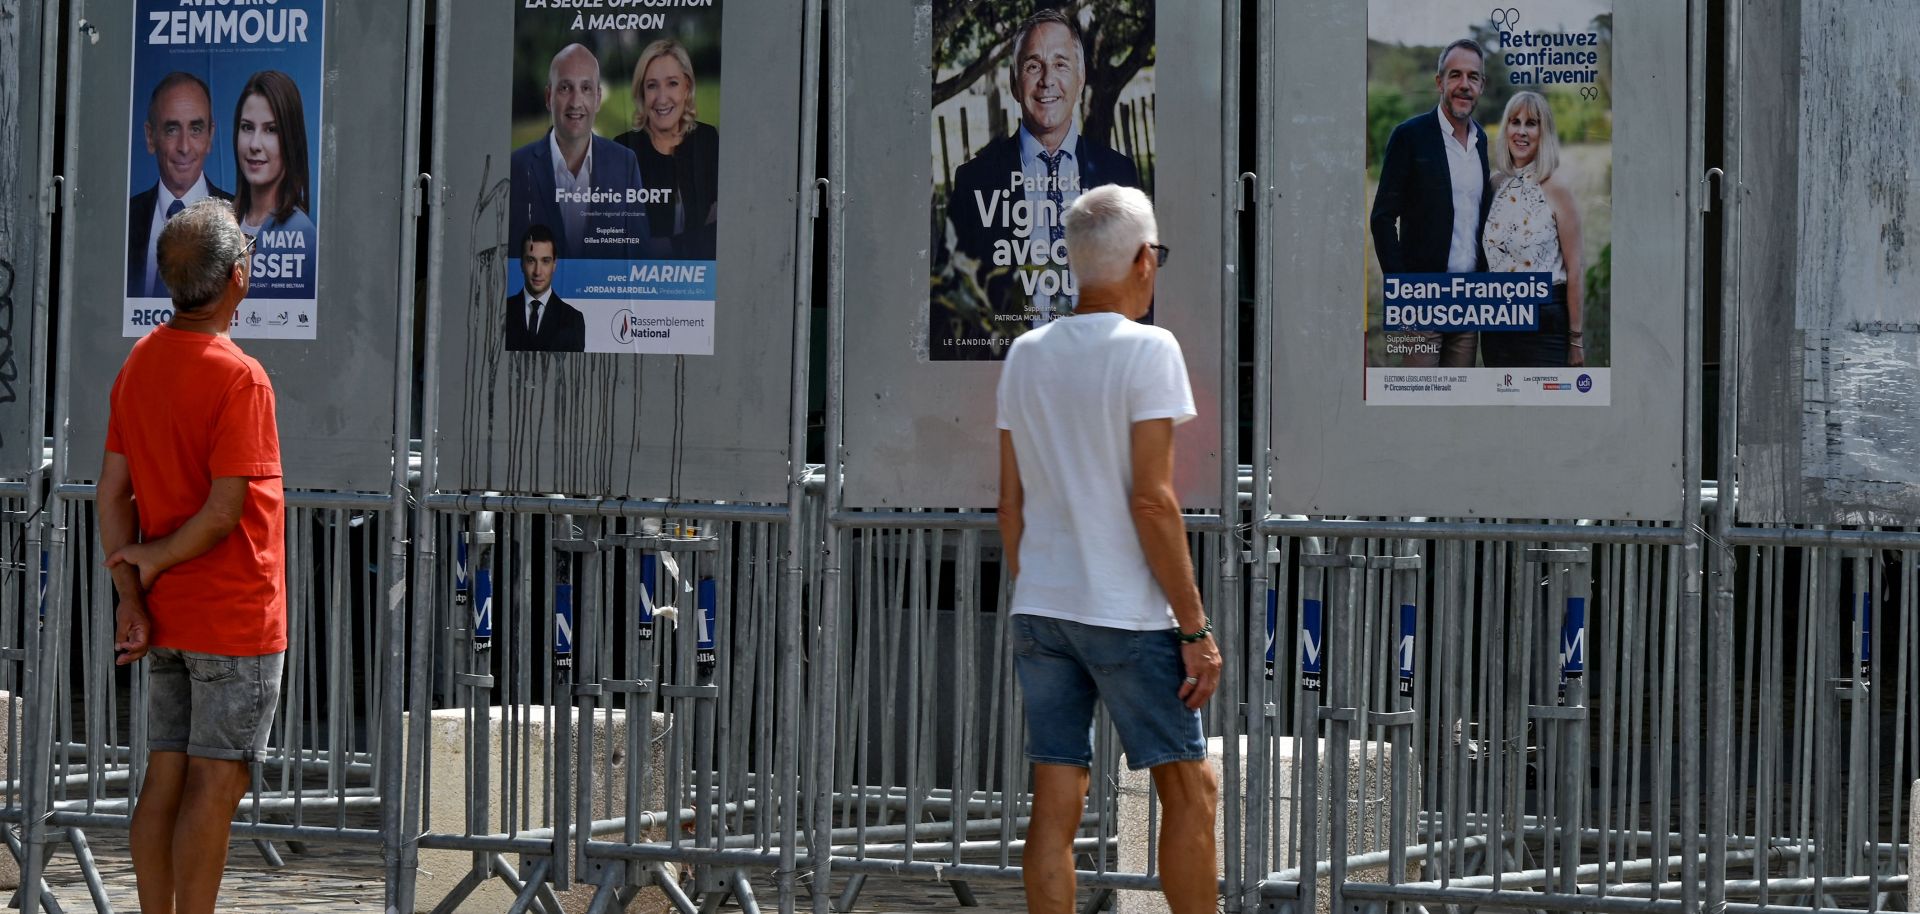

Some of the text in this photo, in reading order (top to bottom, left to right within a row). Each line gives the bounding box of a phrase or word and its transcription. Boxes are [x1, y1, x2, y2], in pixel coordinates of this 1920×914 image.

[149, 9, 309, 45] ZEMMOUR
[570, 10, 665, 30] À MACRON
[1500, 30, 1598, 48] Retrouvez
[1504, 48, 1598, 66] confiance
[1509, 65, 1598, 85] en l'avenir
[1010, 170, 1081, 193] Patrick
[555, 187, 672, 204] Frédéric BORT
[974, 188, 1090, 238] Vigna
[262, 230, 306, 249] MAYA
[608, 265, 707, 283] avec MARINE
[1020, 269, 1079, 296] vou
[583, 286, 615, 294] JORDAN
[1385, 276, 1549, 304] Jean-François
[631, 316, 705, 327] Rassemblement
[1386, 304, 1534, 326] BOUSCARAIN
[631, 328, 670, 339] National
[1387, 335, 1426, 343] Suppléante
[1387, 344, 1439, 355] Cathy POHL
